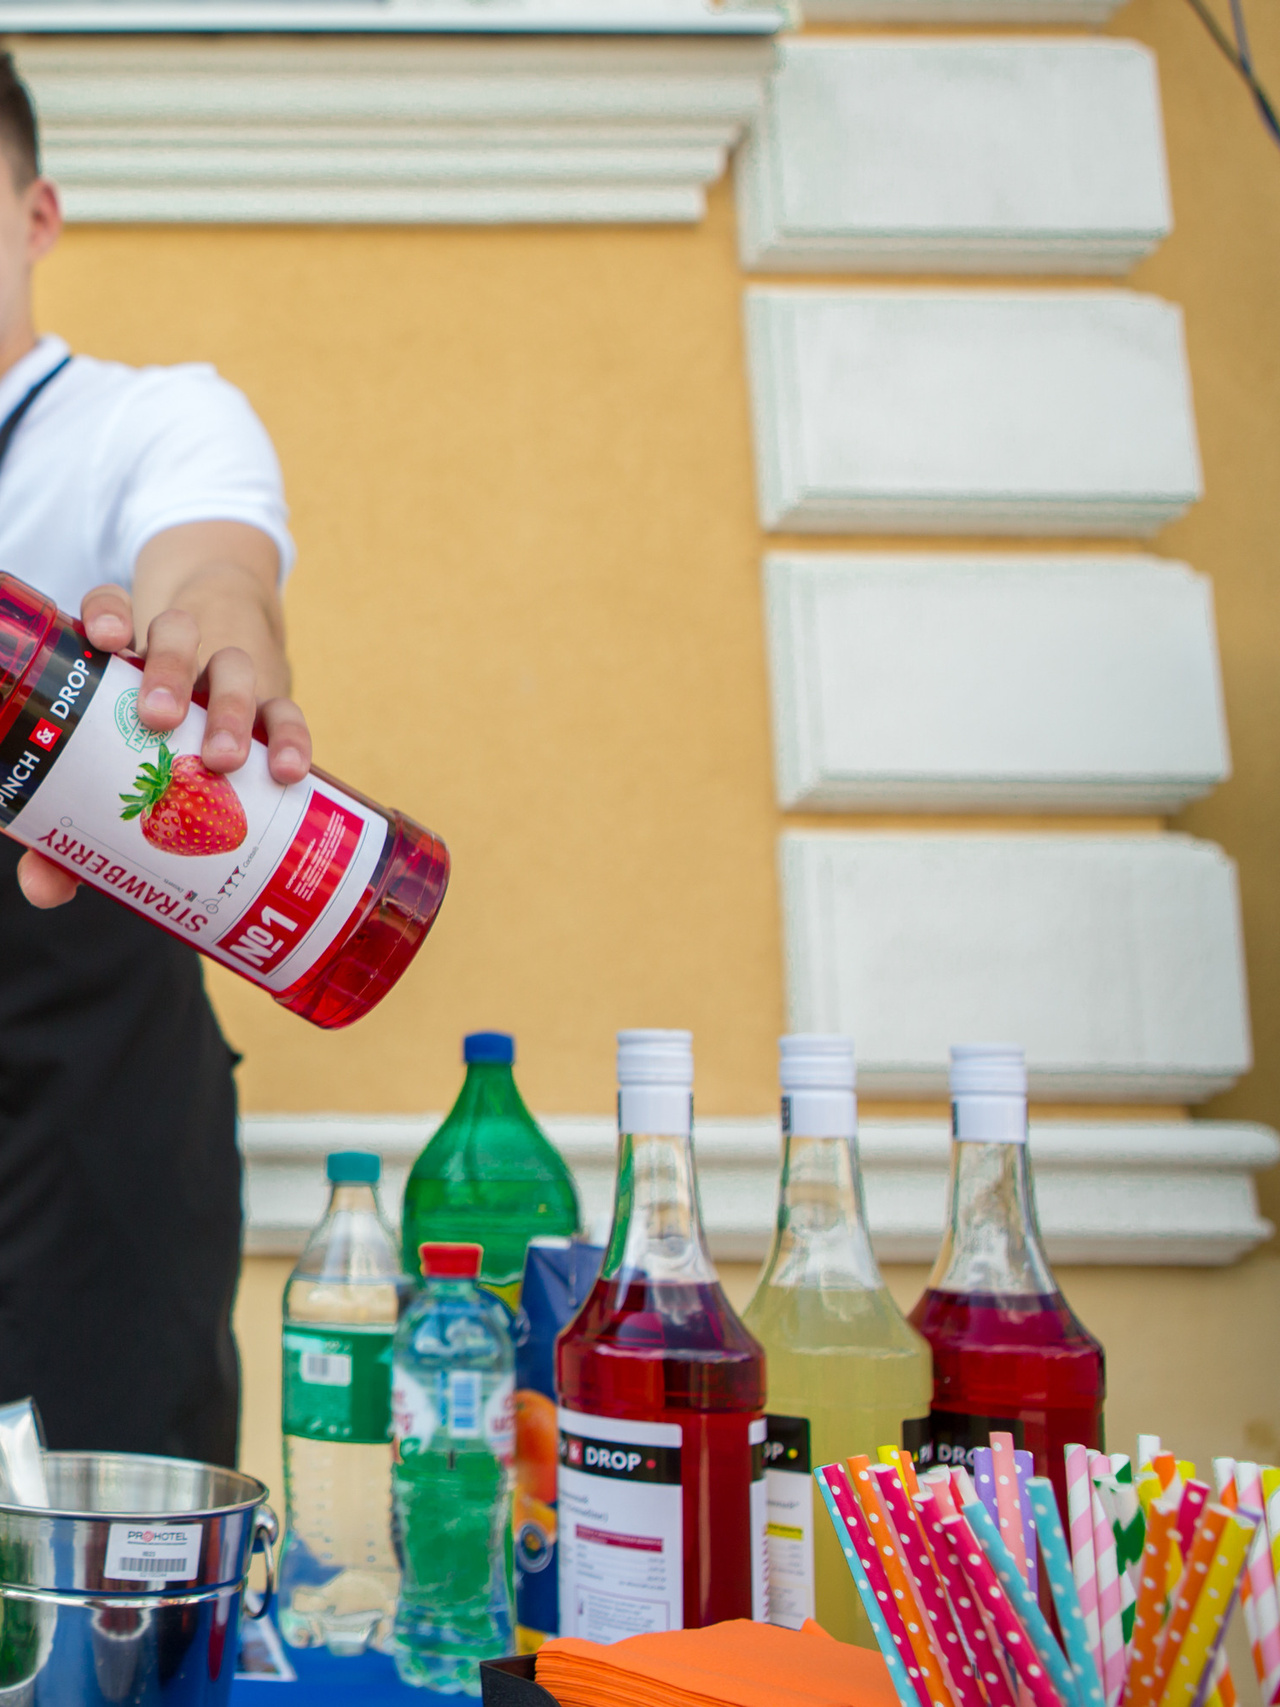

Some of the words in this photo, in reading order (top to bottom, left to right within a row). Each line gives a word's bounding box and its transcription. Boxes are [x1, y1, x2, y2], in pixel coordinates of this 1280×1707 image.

[36, 727, 55, 744] &
[50, 658, 90, 720] DROP
[37, 828, 208, 933] STRAWBERRY
[585, 1445, 642, 1472] DROP
